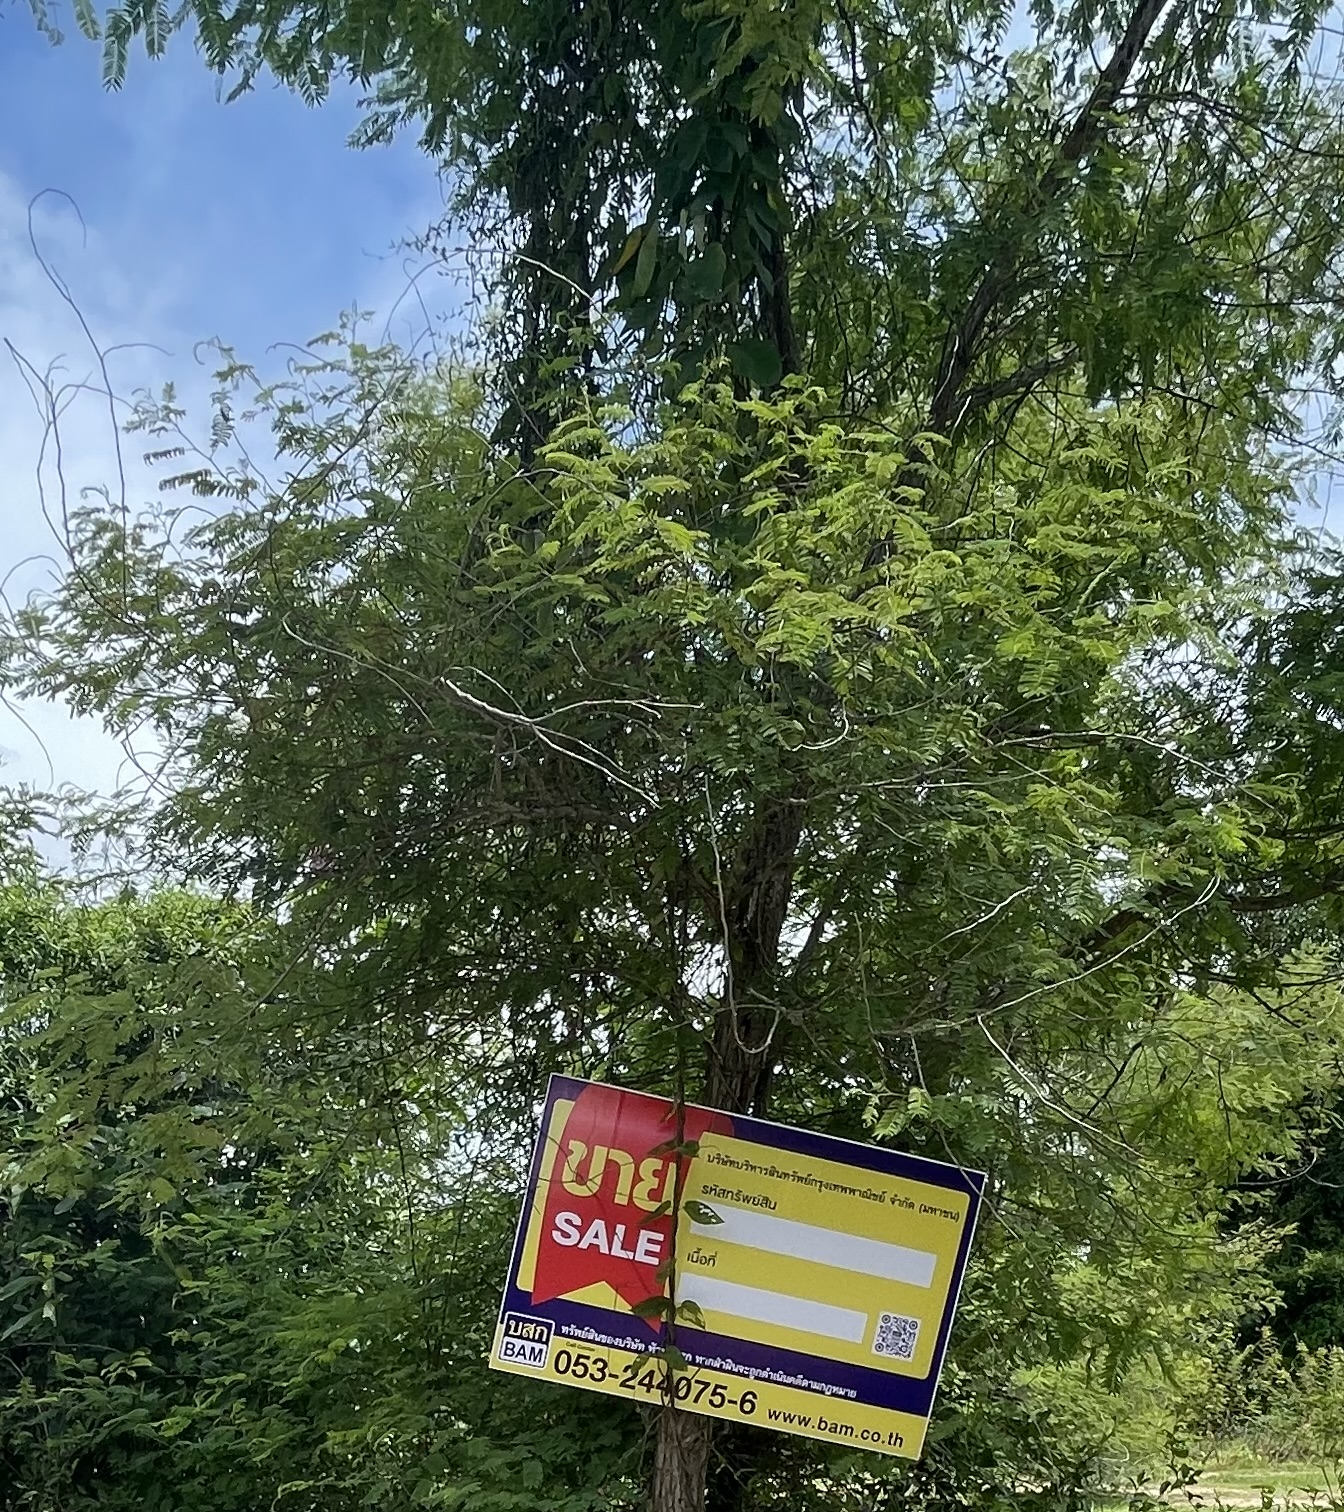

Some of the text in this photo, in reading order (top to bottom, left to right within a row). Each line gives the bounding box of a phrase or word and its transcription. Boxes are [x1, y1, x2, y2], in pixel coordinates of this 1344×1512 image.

[561, 1139, 676, 1216] ขาย
[701, 1183, 777, 1211] รหัสทรัพย์สิน
[918, 1203, 960, 1223] (มหาชน)
[551, 1211, 665, 1266] SALE
[687, 1246, 718, 1268] เนื้อที่
[508, 1320, 548, 1342] บสก
[503, 1341, 544, 1364] BAM
[554, 1349, 759, 1415] 053-244075-6
[767, 1408, 904, 1448] www.bam.co.th
